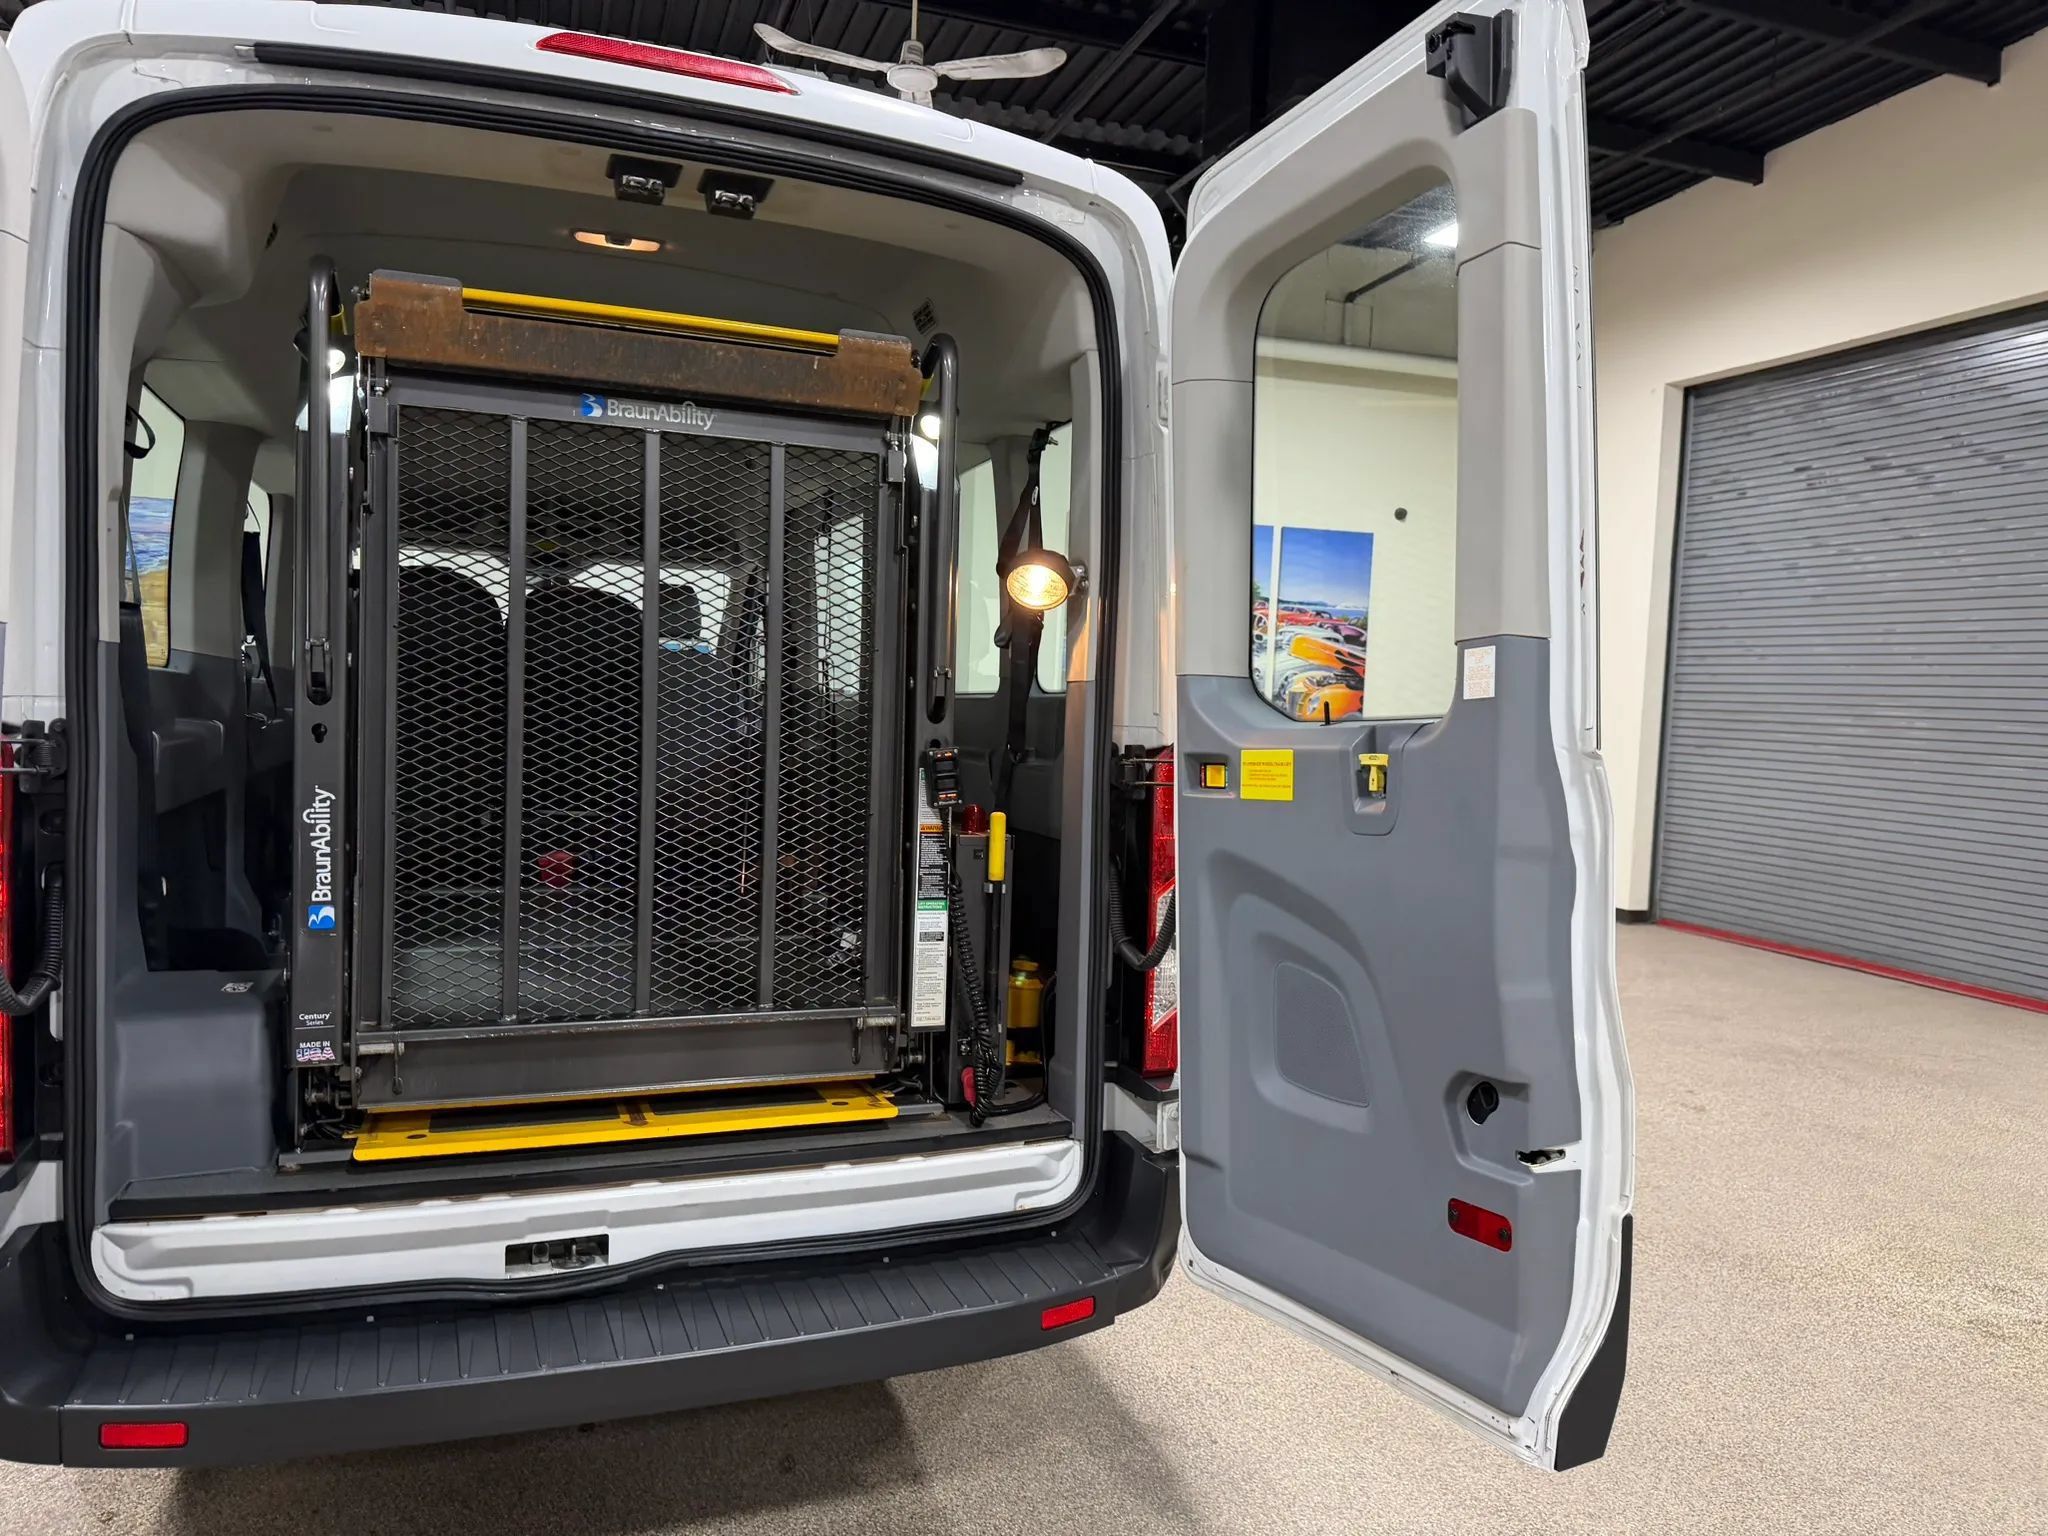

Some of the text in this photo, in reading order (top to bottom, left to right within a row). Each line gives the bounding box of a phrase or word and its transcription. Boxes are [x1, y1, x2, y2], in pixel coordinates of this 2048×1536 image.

[607, 399, 716, 430] BraunAbility
[302, 788, 336, 902] BraunAbility
[296, 1047, 336, 1062] USA
